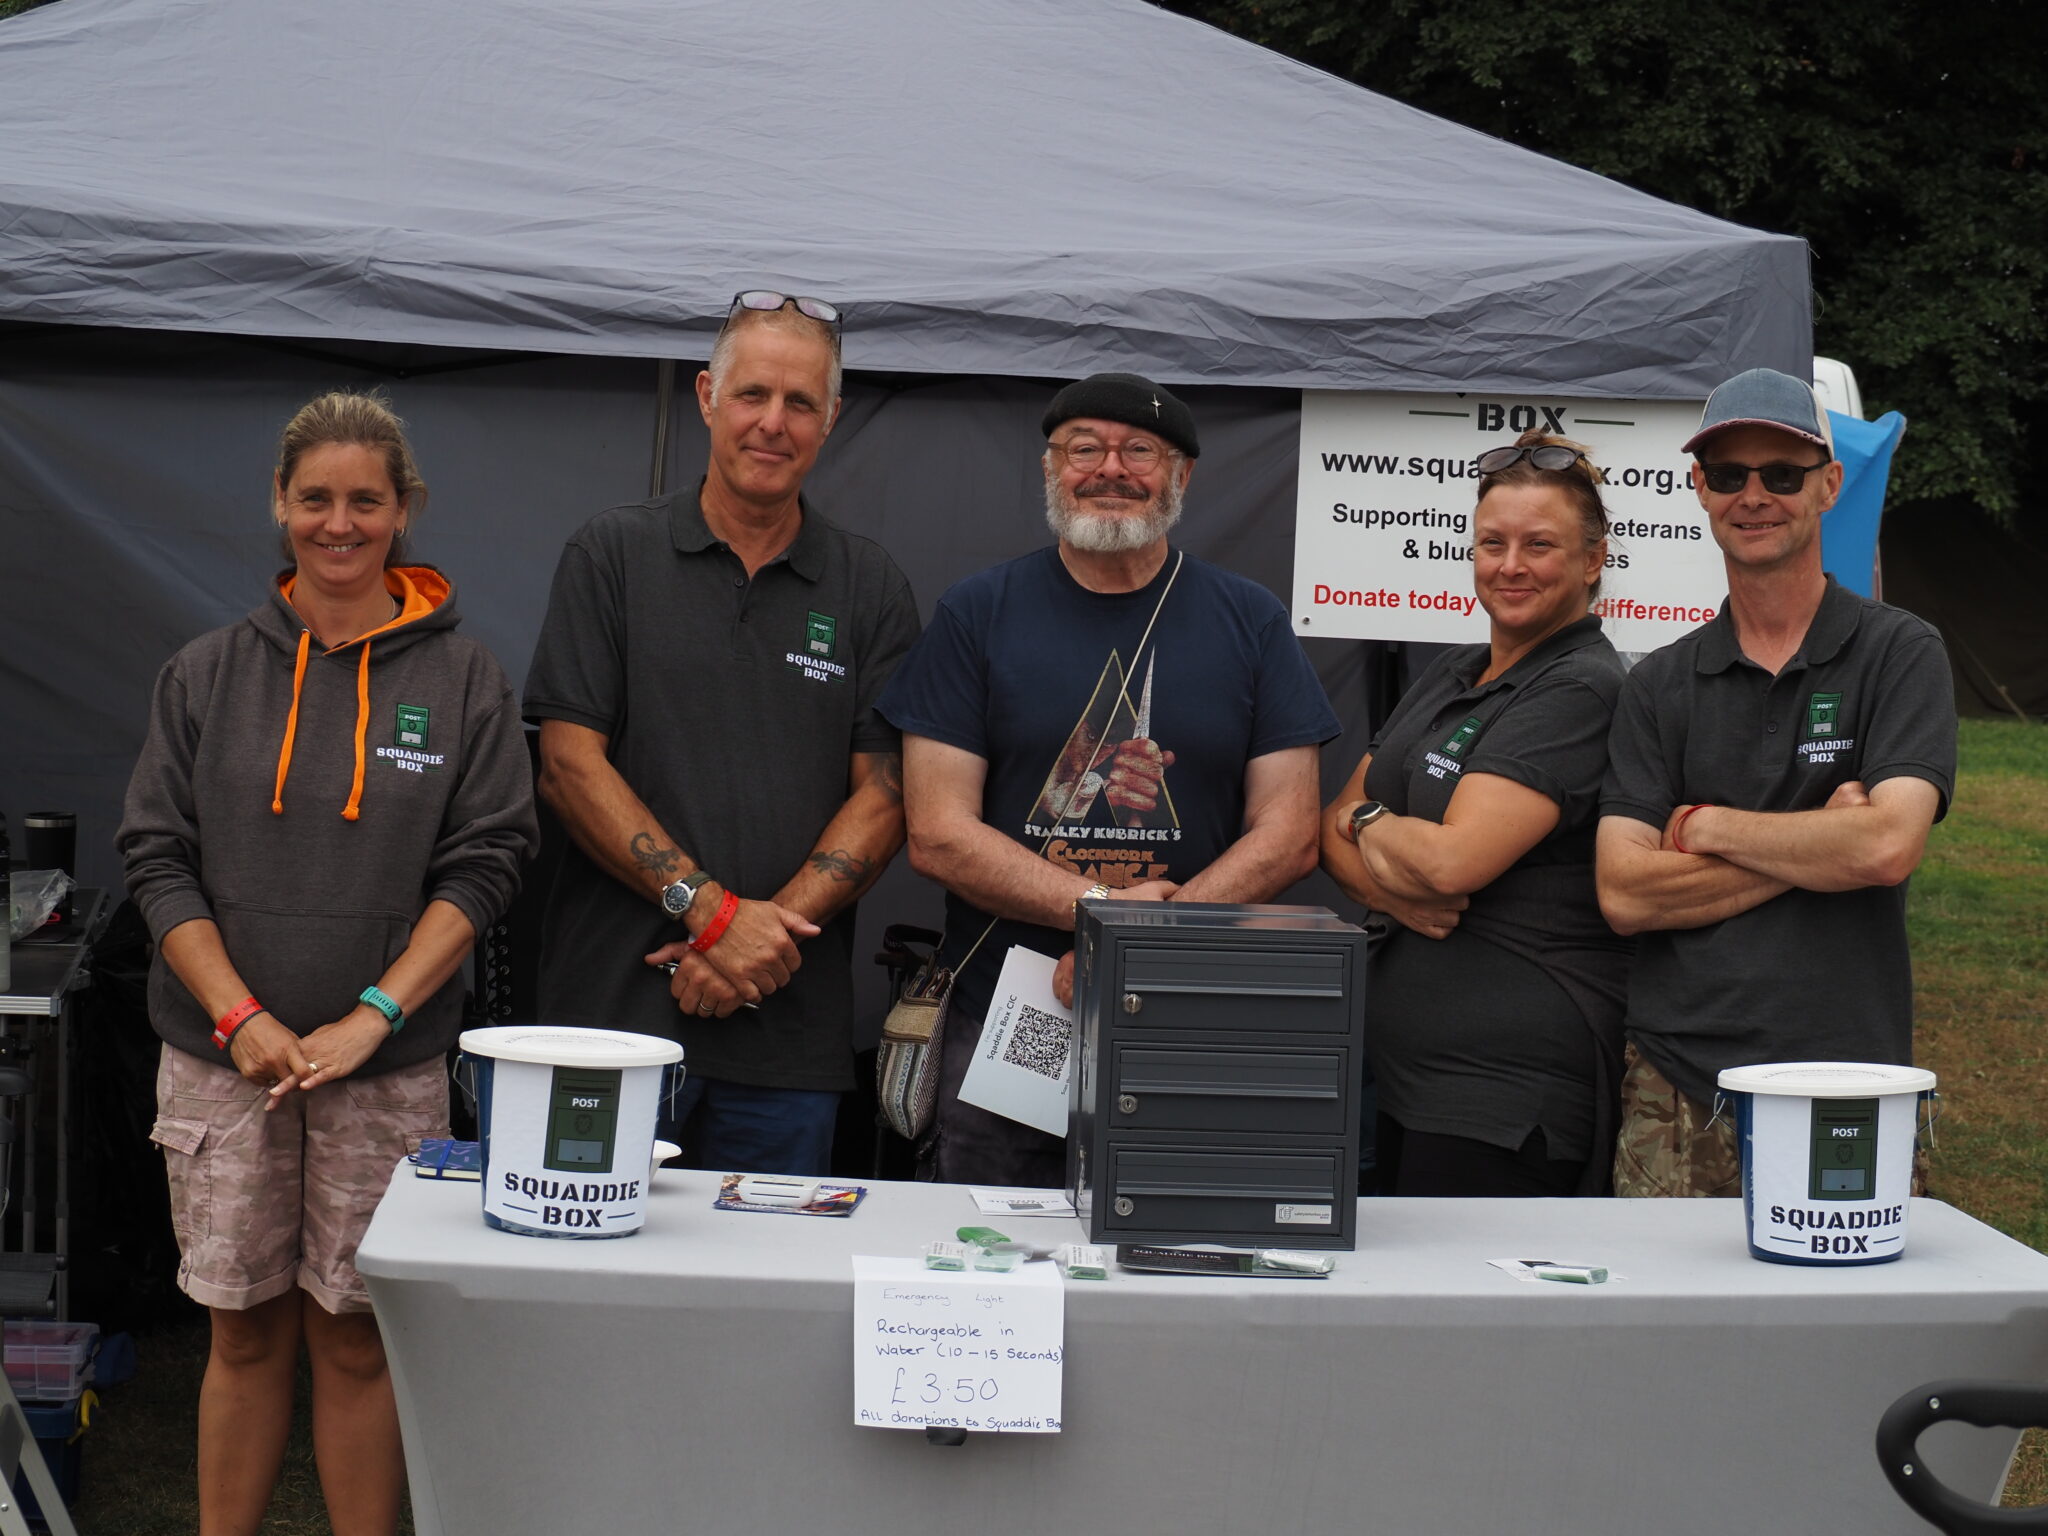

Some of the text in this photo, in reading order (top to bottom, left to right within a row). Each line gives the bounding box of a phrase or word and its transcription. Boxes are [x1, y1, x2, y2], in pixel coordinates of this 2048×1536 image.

[1478, 403, 1568, 435] BOX
[1332, 503, 1467, 534] Supporting
[1402, 539, 1475, 562] & blue
[1314, 584, 1477, 616] Donate today
[1594, 599, 1716, 623] difference
[786, 652, 845, 676] SQUADDIE
[804, 667, 828, 682] BOX
[376, 747, 444, 765] SQUADDIE
[1797, 739, 1854, 755] SQUADDIE
[1809, 752, 1835, 763] BOX
[397, 759, 423, 773] BOX
[1425, 752, 1461, 775] SQUADDI
[1427, 764, 1447, 779] BOX
[987, 995, 1017, 1060] Sqaddie Box CIC
[572, 1097, 599, 1108] POST
[1832, 1128, 1859, 1137] POST
[505, 1172, 640, 1202] SQUADDIE
[543, 1205, 603, 1227] BOX
[1770, 1205, 1902, 1231] SQUADDIE
[1811, 1235, 1869, 1254] BOX
[883, 1288, 951, 1306] Emergency
[876, 1318, 1014, 1341] Rechargeable in
[876, 1343, 925, 1356] Water
[891, 1410, 959, 1427] donations
[966, 1416, 979, 1427] to
[985, 1416, 1040, 1432] Squaddie
